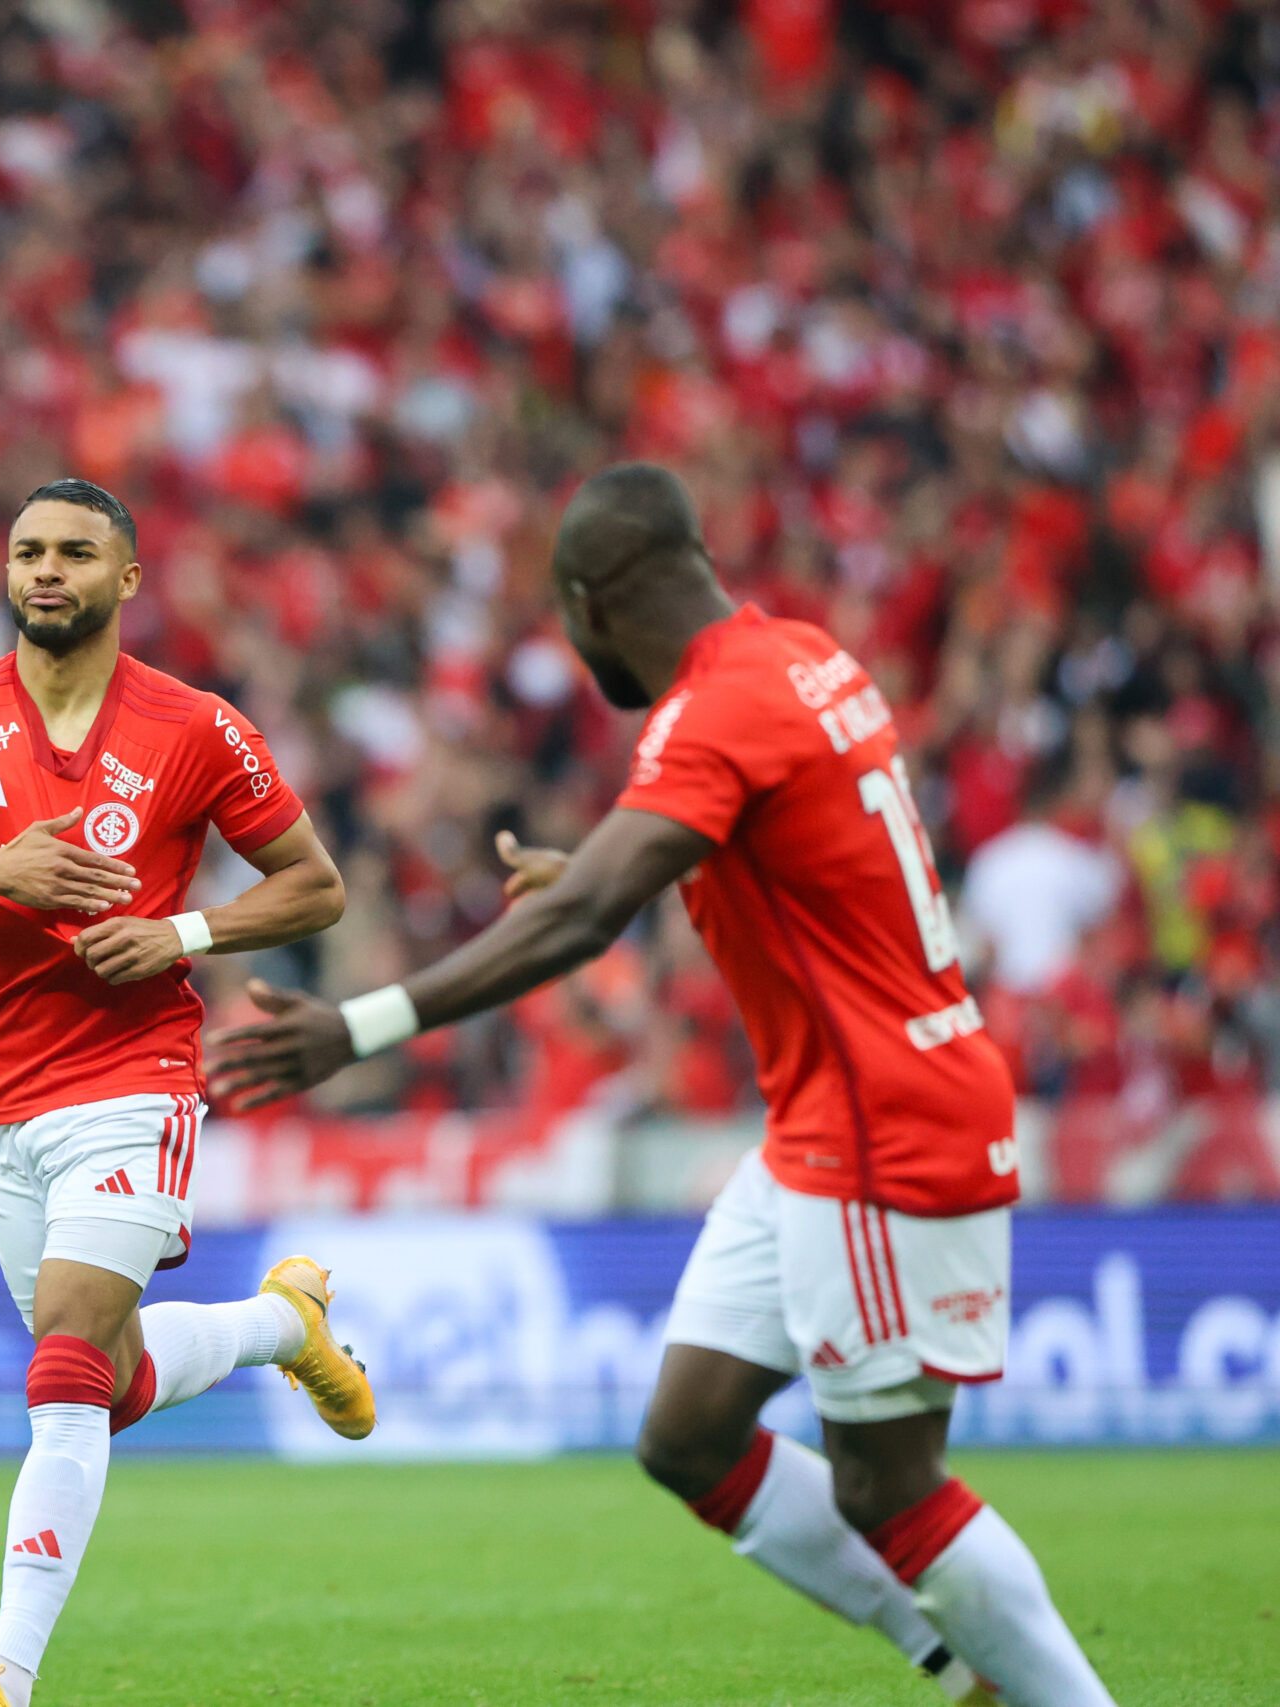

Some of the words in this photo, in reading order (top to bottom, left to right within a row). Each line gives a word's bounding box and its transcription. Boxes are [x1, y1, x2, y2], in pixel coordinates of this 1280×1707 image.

[215, 708, 259, 773] vero
[100, 751, 155, 792] ESTRELA
[110, 778, 142, 802] BET
